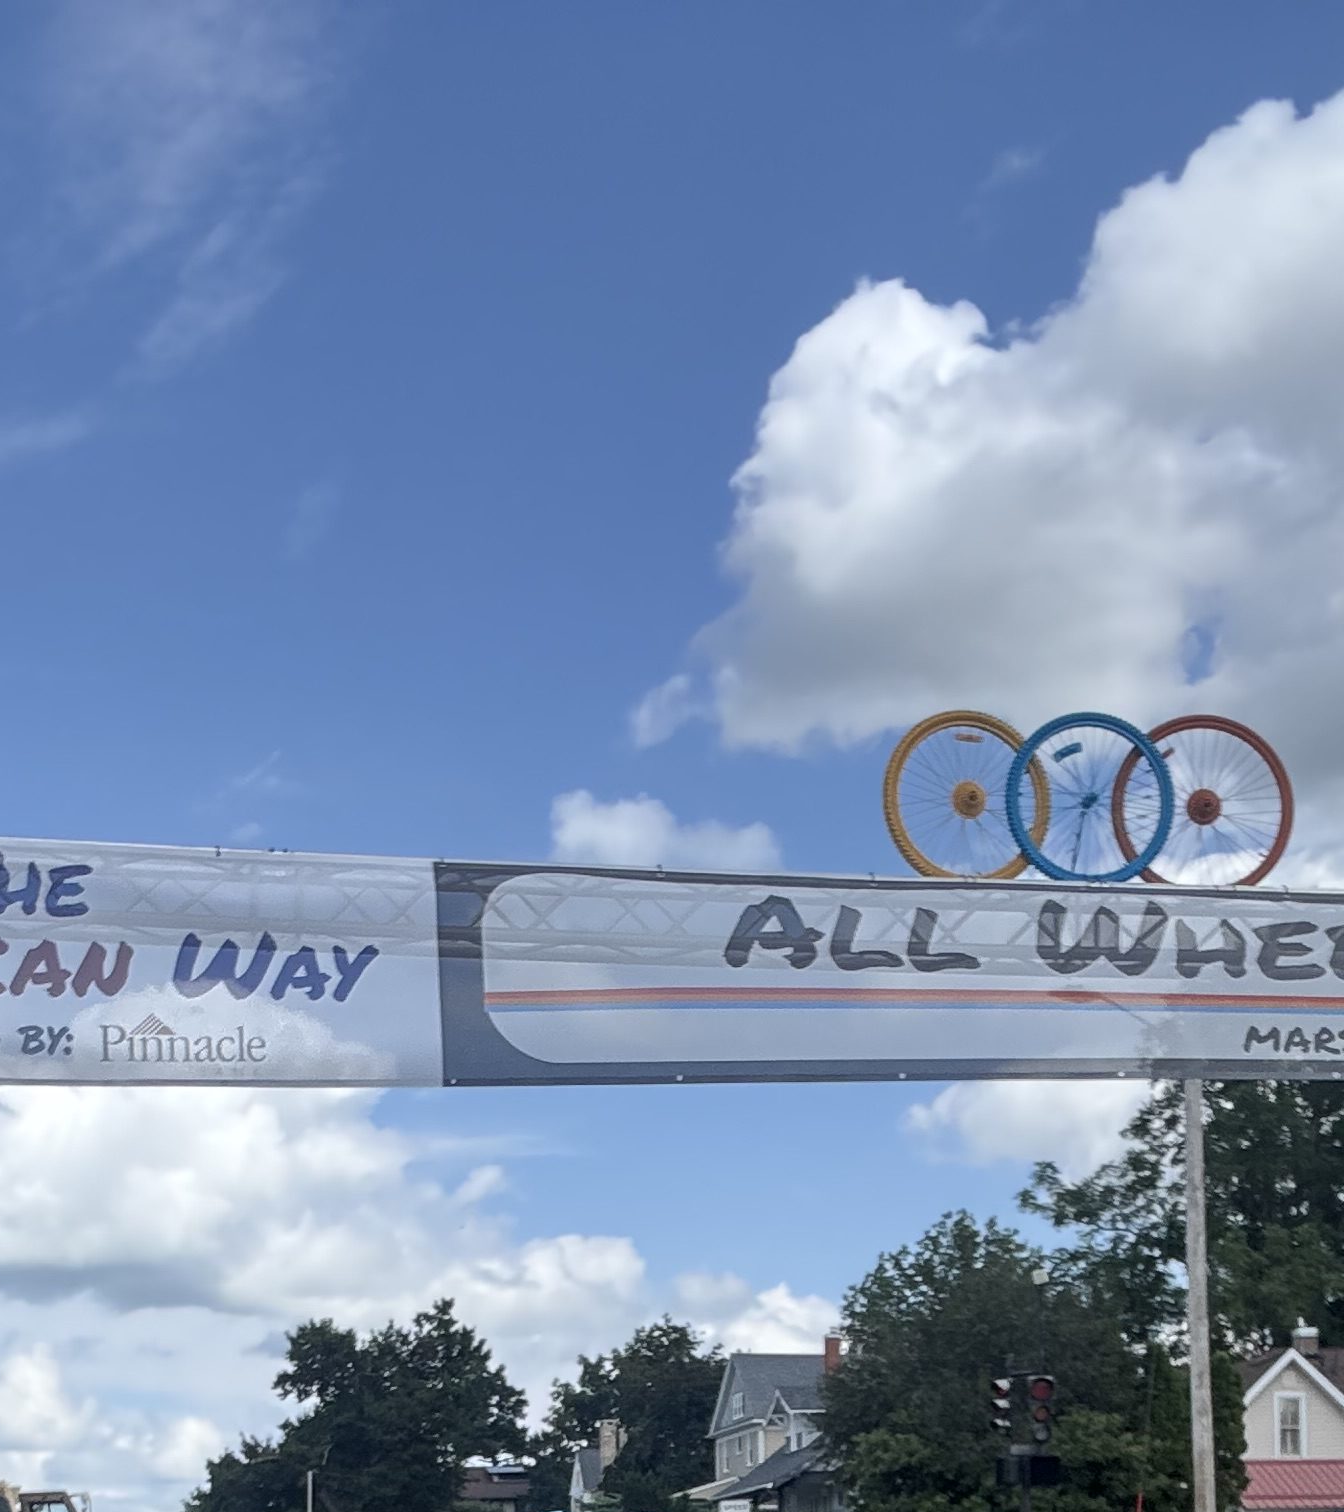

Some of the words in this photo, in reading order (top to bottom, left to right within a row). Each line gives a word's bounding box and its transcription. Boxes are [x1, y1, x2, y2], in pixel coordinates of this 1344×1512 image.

[722, 894, 981, 973] ALL
[172, 930, 380, 1003] WAY
[17, 1025, 74, 1057] BY:
[99, 1024, 267, 1064] Pinnacle
